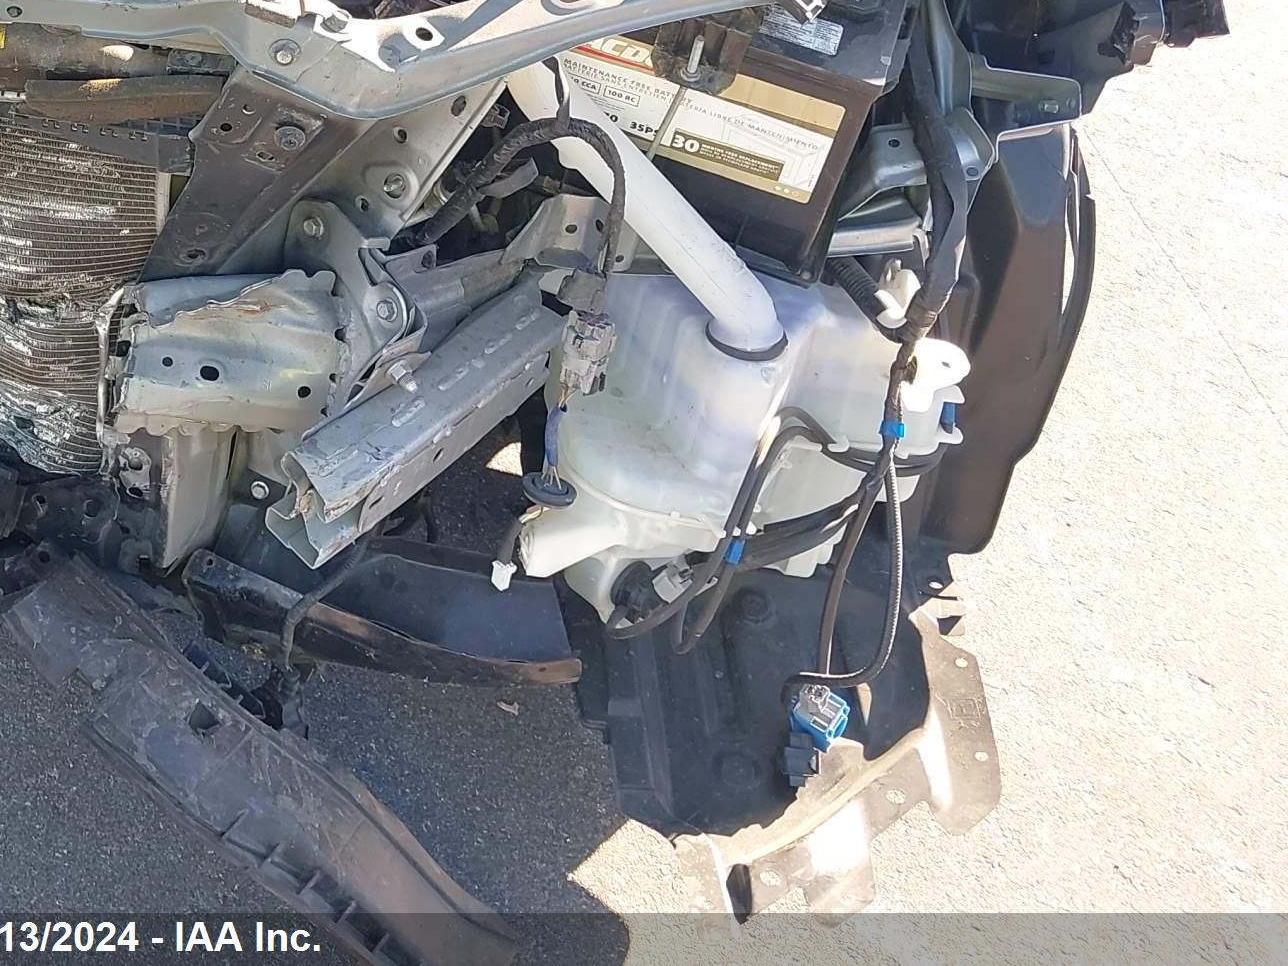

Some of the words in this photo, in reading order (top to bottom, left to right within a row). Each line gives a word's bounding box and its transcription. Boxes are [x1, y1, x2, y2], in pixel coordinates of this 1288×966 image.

[564, 58, 628, 83] MAINTENANCE
[631, 79, 650, 91] FREE
[581, 80, 597, 91] CCA
[624, 94, 636, 103] RC
[672, 135, 700, 153] 30
